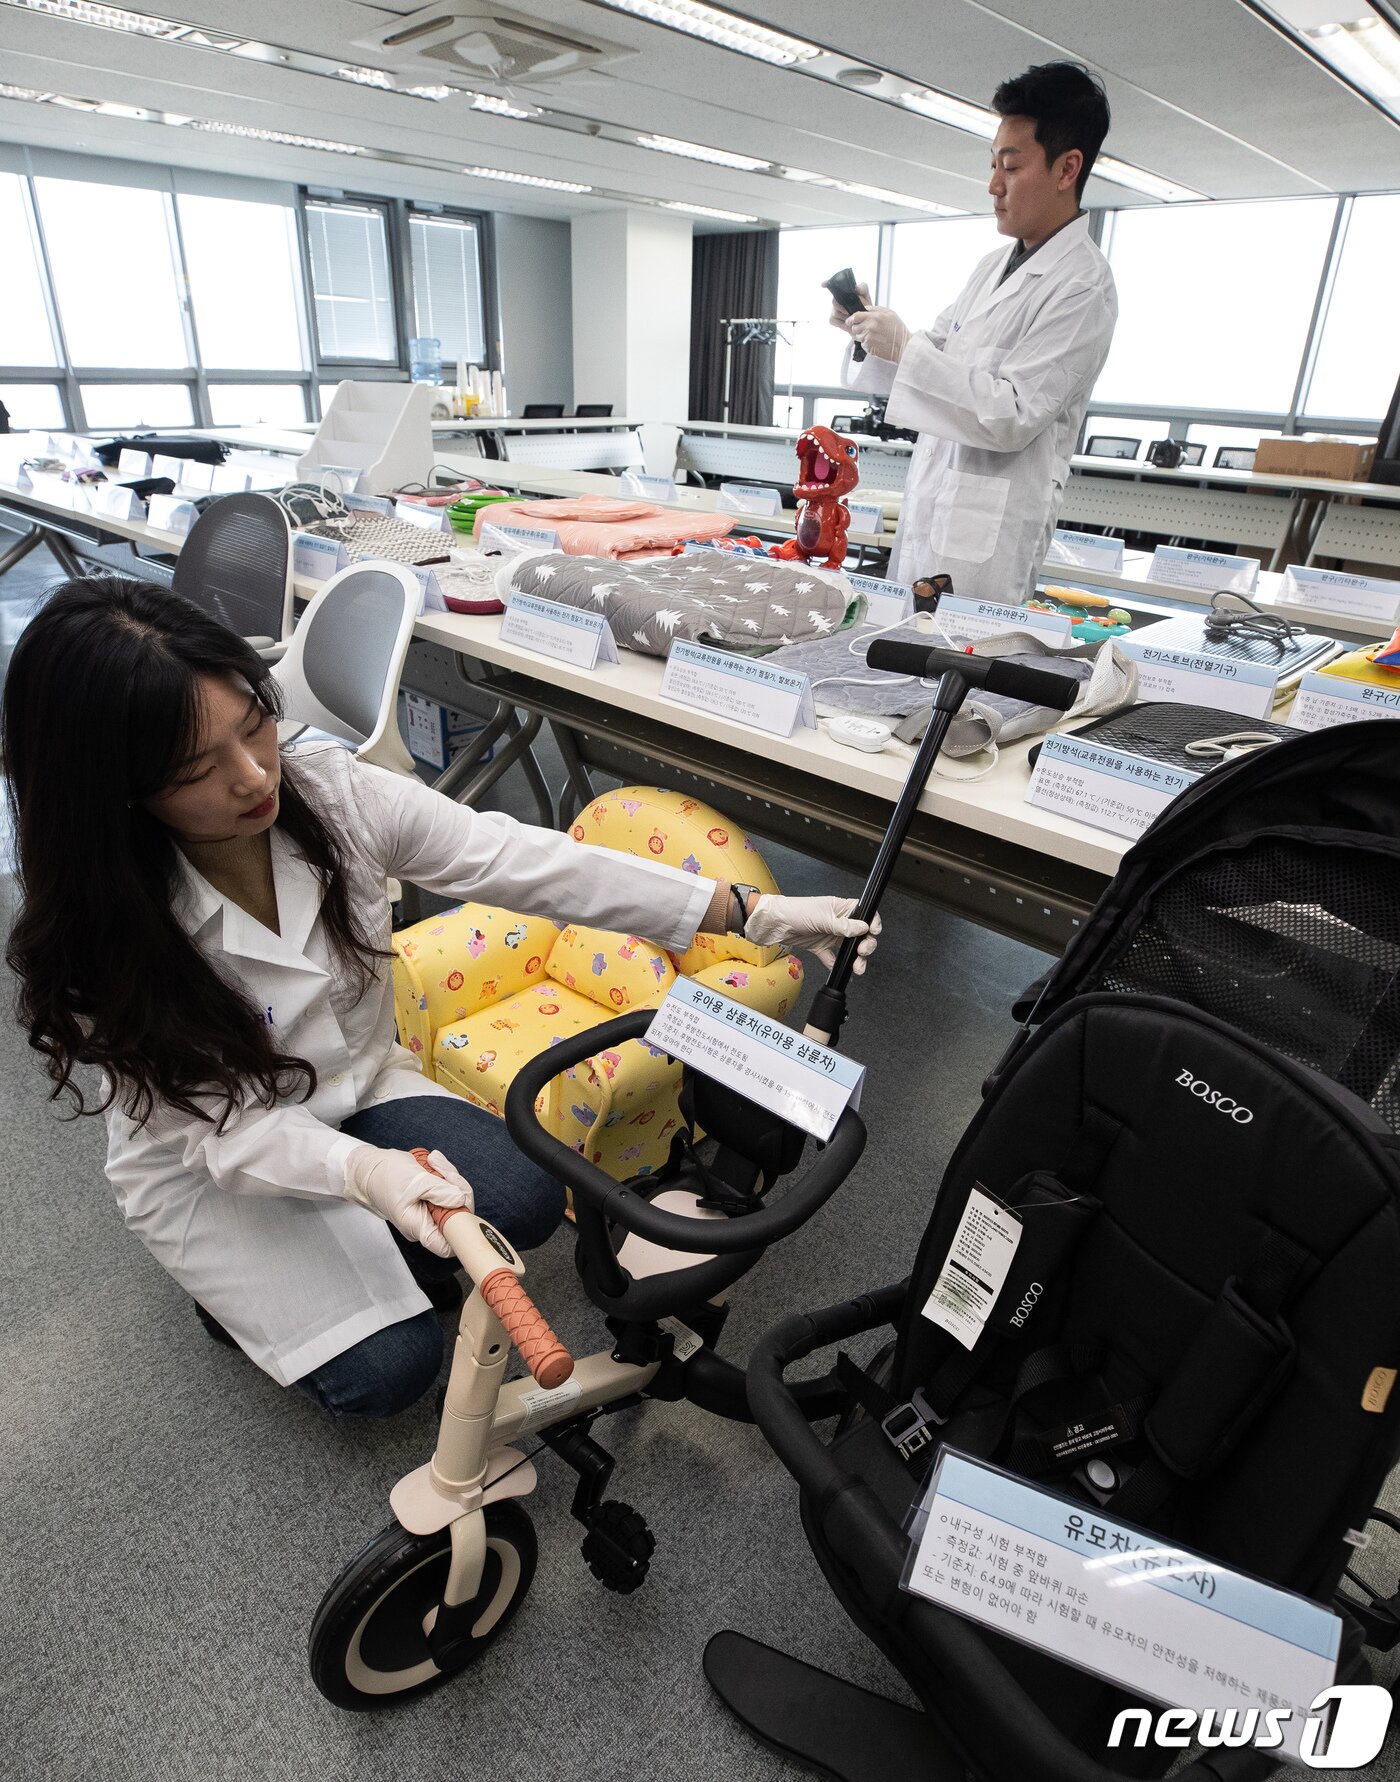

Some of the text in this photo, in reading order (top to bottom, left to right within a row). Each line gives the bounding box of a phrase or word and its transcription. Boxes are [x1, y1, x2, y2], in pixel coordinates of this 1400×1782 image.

[1321, 574, 1368, 588] 완구(기타완구)
[978, 604, 1028, 622] 완구(유아완구)
[675, 646, 722, 666] 전기방석(교류전원을
[723, 660, 744, 672] 사용하는
[746, 666, 758, 676] 전기
[1142, 648, 1237, 677] 전기스토브(전열기구)
[1045, 739, 1184, 788] 전기방석(교류전원을 사용하는 전기
[1052, 782, 1075, 795] (측정값)
[1076, 788, 1088, 798] 67.1
[1100, 796, 1125, 812] (기준값)
[1126, 804, 1134, 814] 50
[1066, 776, 1085, 788] 부적합
[1076, 798, 1098, 814] (측정값)
[682, 1010, 700, 1024] 부적합
[692, 990, 836, 1074] 유아용 삼륜차(유아용 삼륜차)
[651, 1028, 662, 1039] 되지
[1175, 1068, 1253, 1124] BOSCO
[1010, 1282, 1044, 1328] BOSCO
[950, 1516, 1048, 1568] 내구성 시험 부적합
[946, 1534, 1089, 1606] 측정값: 시험 중 앞바퀴 파손
[923, 1565, 1038, 1625] 또는 변형이 없어야 함
[940, 1552, 977, 1578] 기준치:
[980, 1570, 1016, 1596] 6.4.9에
[1020, 1586, 1044, 1606] 따라
[1048, 1600, 1082, 1623] 시험할
[1085, 1614, 1098, 1630] 때
[1100, 1622, 1148, 1652] 유모차의
[1152, 1642, 1200, 1675] 안전성을
[1204, 1665, 1251, 1698] 저해하는
